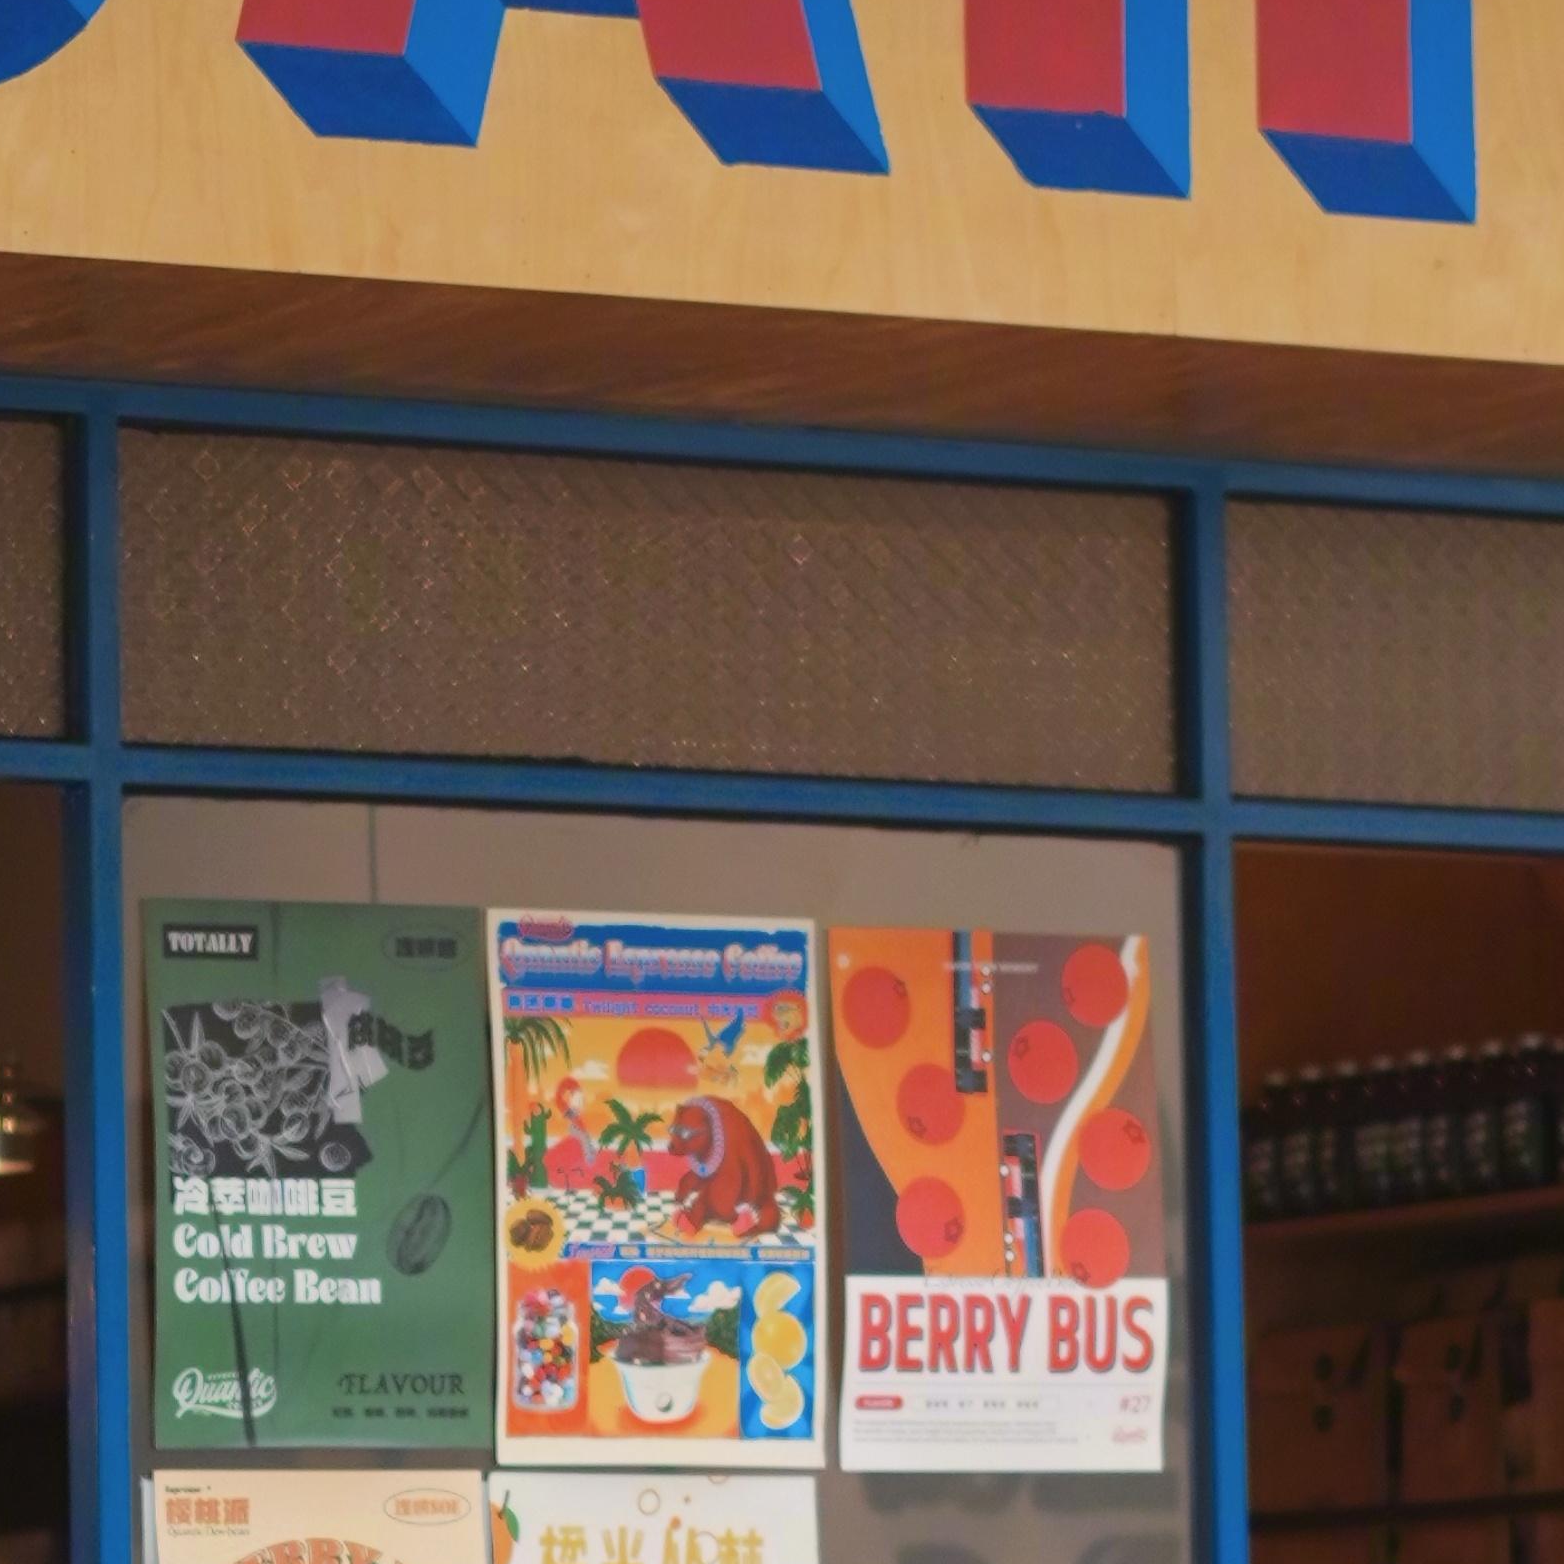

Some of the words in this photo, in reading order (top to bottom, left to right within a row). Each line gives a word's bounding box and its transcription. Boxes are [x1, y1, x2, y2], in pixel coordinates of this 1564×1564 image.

[167, 931, 254, 955] TOTALLY
[173, 1177, 358, 1216] 冷萃咖啡豆
[173, 1223, 257, 1260] Cold
[263, 1224, 358, 1260] Brew
[173, 1268, 285, 1305] Coffee
[293, 1269, 382, 1305] Bean
[858, 1292, 1031, 1373] BERRY
[1047, 1293, 1155, 1374] BUS
[172, 1367, 278, 1419] Quanic
